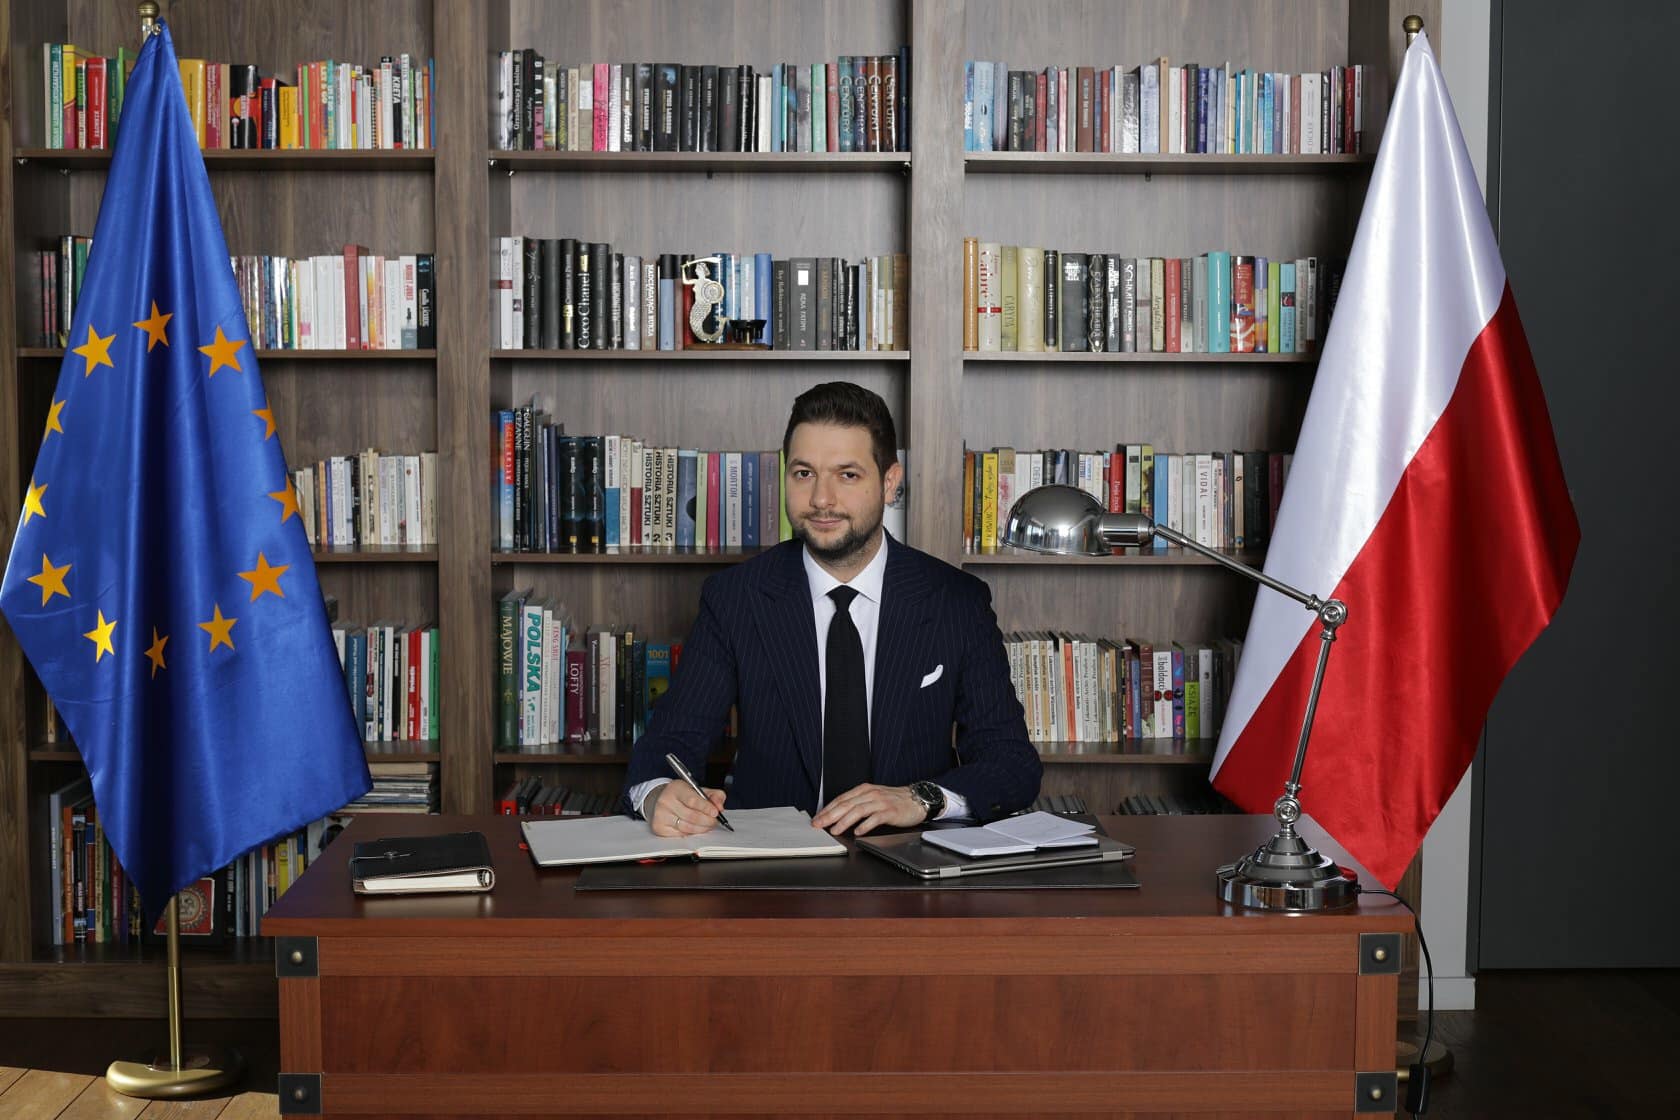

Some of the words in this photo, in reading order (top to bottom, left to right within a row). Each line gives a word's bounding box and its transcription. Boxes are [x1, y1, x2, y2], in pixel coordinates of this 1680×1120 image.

[840, 76, 852, 134] CENTURY
[855, 77, 866, 134] CENTURY
[869, 75, 881, 131] CENTURY
[885, 74, 895, 130] CENTURY
[578, 273, 590, 316] Chanel
[980, 251, 993, 298] Cabré
[1124, 264, 1133, 309] SCHMITT
[1004, 296, 1015, 328] CARYCA
[578, 317, 590, 349] Coco
[666, 454, 674, 494] HISTORIA
[730, 466, 738, 498] MORTON
[1200, 472, 1208, 499] VIDAL
[653, 534, 660, 542] 2
[665, 533, 672, 541] 3
[500, 615, 513, 675] MAJOWIE
[527, 613, 541, 692] POLSKA
[570, 663, 579, 694] LOFTY
[1157, 661, 1168, 690] baldacci
